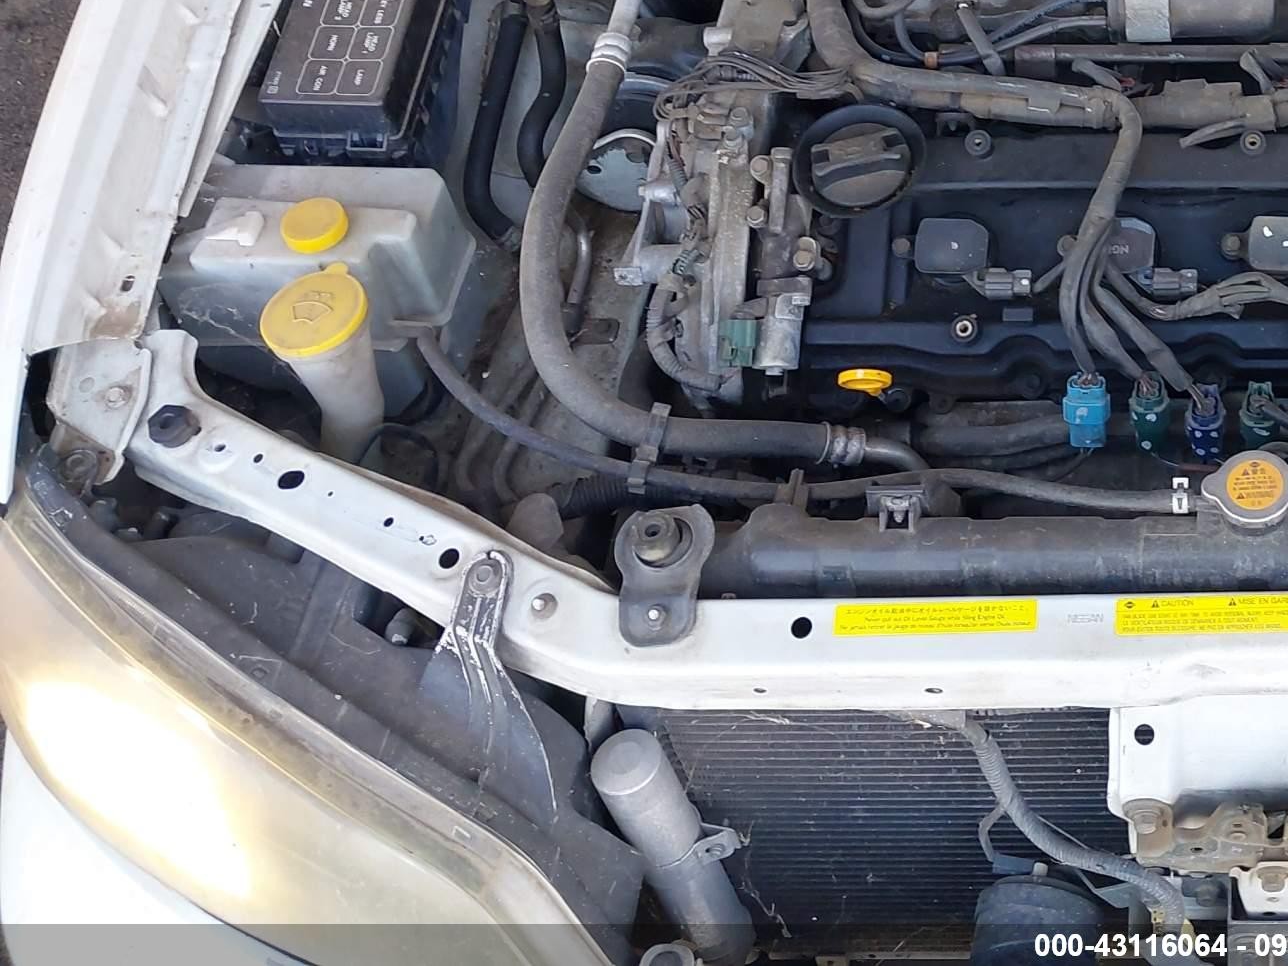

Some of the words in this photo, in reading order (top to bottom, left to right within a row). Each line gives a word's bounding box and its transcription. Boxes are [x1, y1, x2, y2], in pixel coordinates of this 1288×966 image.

[326, 34, 339, 51] HORN
[354, 68, 365, 86] LAMP
[1161, 599, 1194, 607] CAUTION
